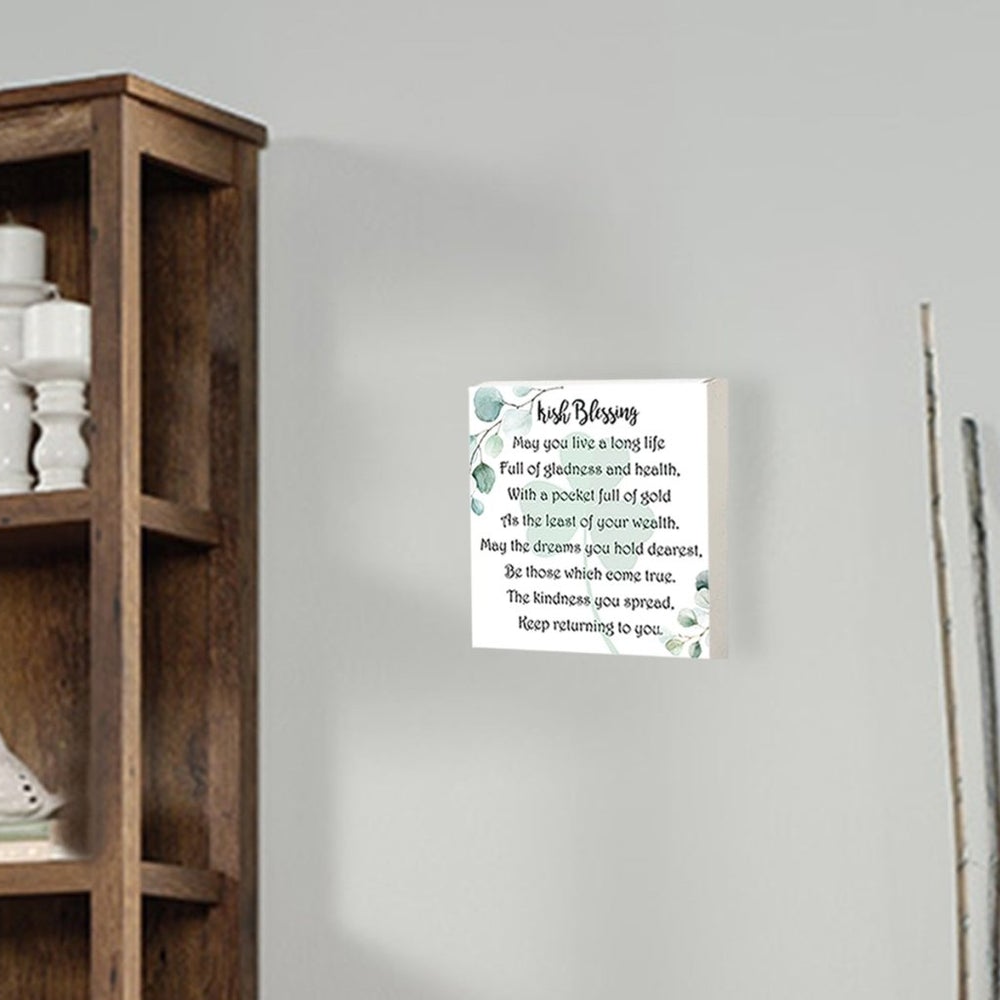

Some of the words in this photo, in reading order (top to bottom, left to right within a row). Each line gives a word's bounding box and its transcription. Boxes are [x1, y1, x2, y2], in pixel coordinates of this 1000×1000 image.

[572, 398, 640, 427] Blessing
[512, 436, 540, 453] May
[543, 438, 568, 453] you
[572, 436, 596, 450] live
[598, 438, 607, 450] a
[610, 435, 641, 453] long
[643, 435, 666, 452] life
[499, 460, 524, 476] Full
[527, 461, 541, 478] of
[543, 462, 603, 479] gladness
[606, 462, 631, 476] and
[507, 487, 537, 501] With
[540, 490, 549, 501] a
[551, 488, 595, 504] pocket
[598, 488, 620, 504] full
[623, 488, 638, 505] of
[640, 489, 671, 506] gold
[500, 513, 520, 528] As
[522, 513, 542, 528] the
[545, 513, 576, 528] least
[579, 514, 594, 531] of
[596, 518, 630, 532] your
[480, 538, 507, 556] May
[510, 539, 530, 553] the
[533, 539, 582, 554] dreams
[584, 543, 610, 557] you
[613, 541, 644, 556] hold
[504, 563, 523, 579] Be
[525, 565, 561, 580] those
[564, 566, 602, 581] which
[605, 570, 642, 583] come
[506, 588, 530, 605] The
[533, 591, 591, 607] kindness
[594, 595, 620, 610] you
[518, 615, 550, 633] Keep
[553, 618, 614, 637] returning
[617, 621, 632, 635] to
